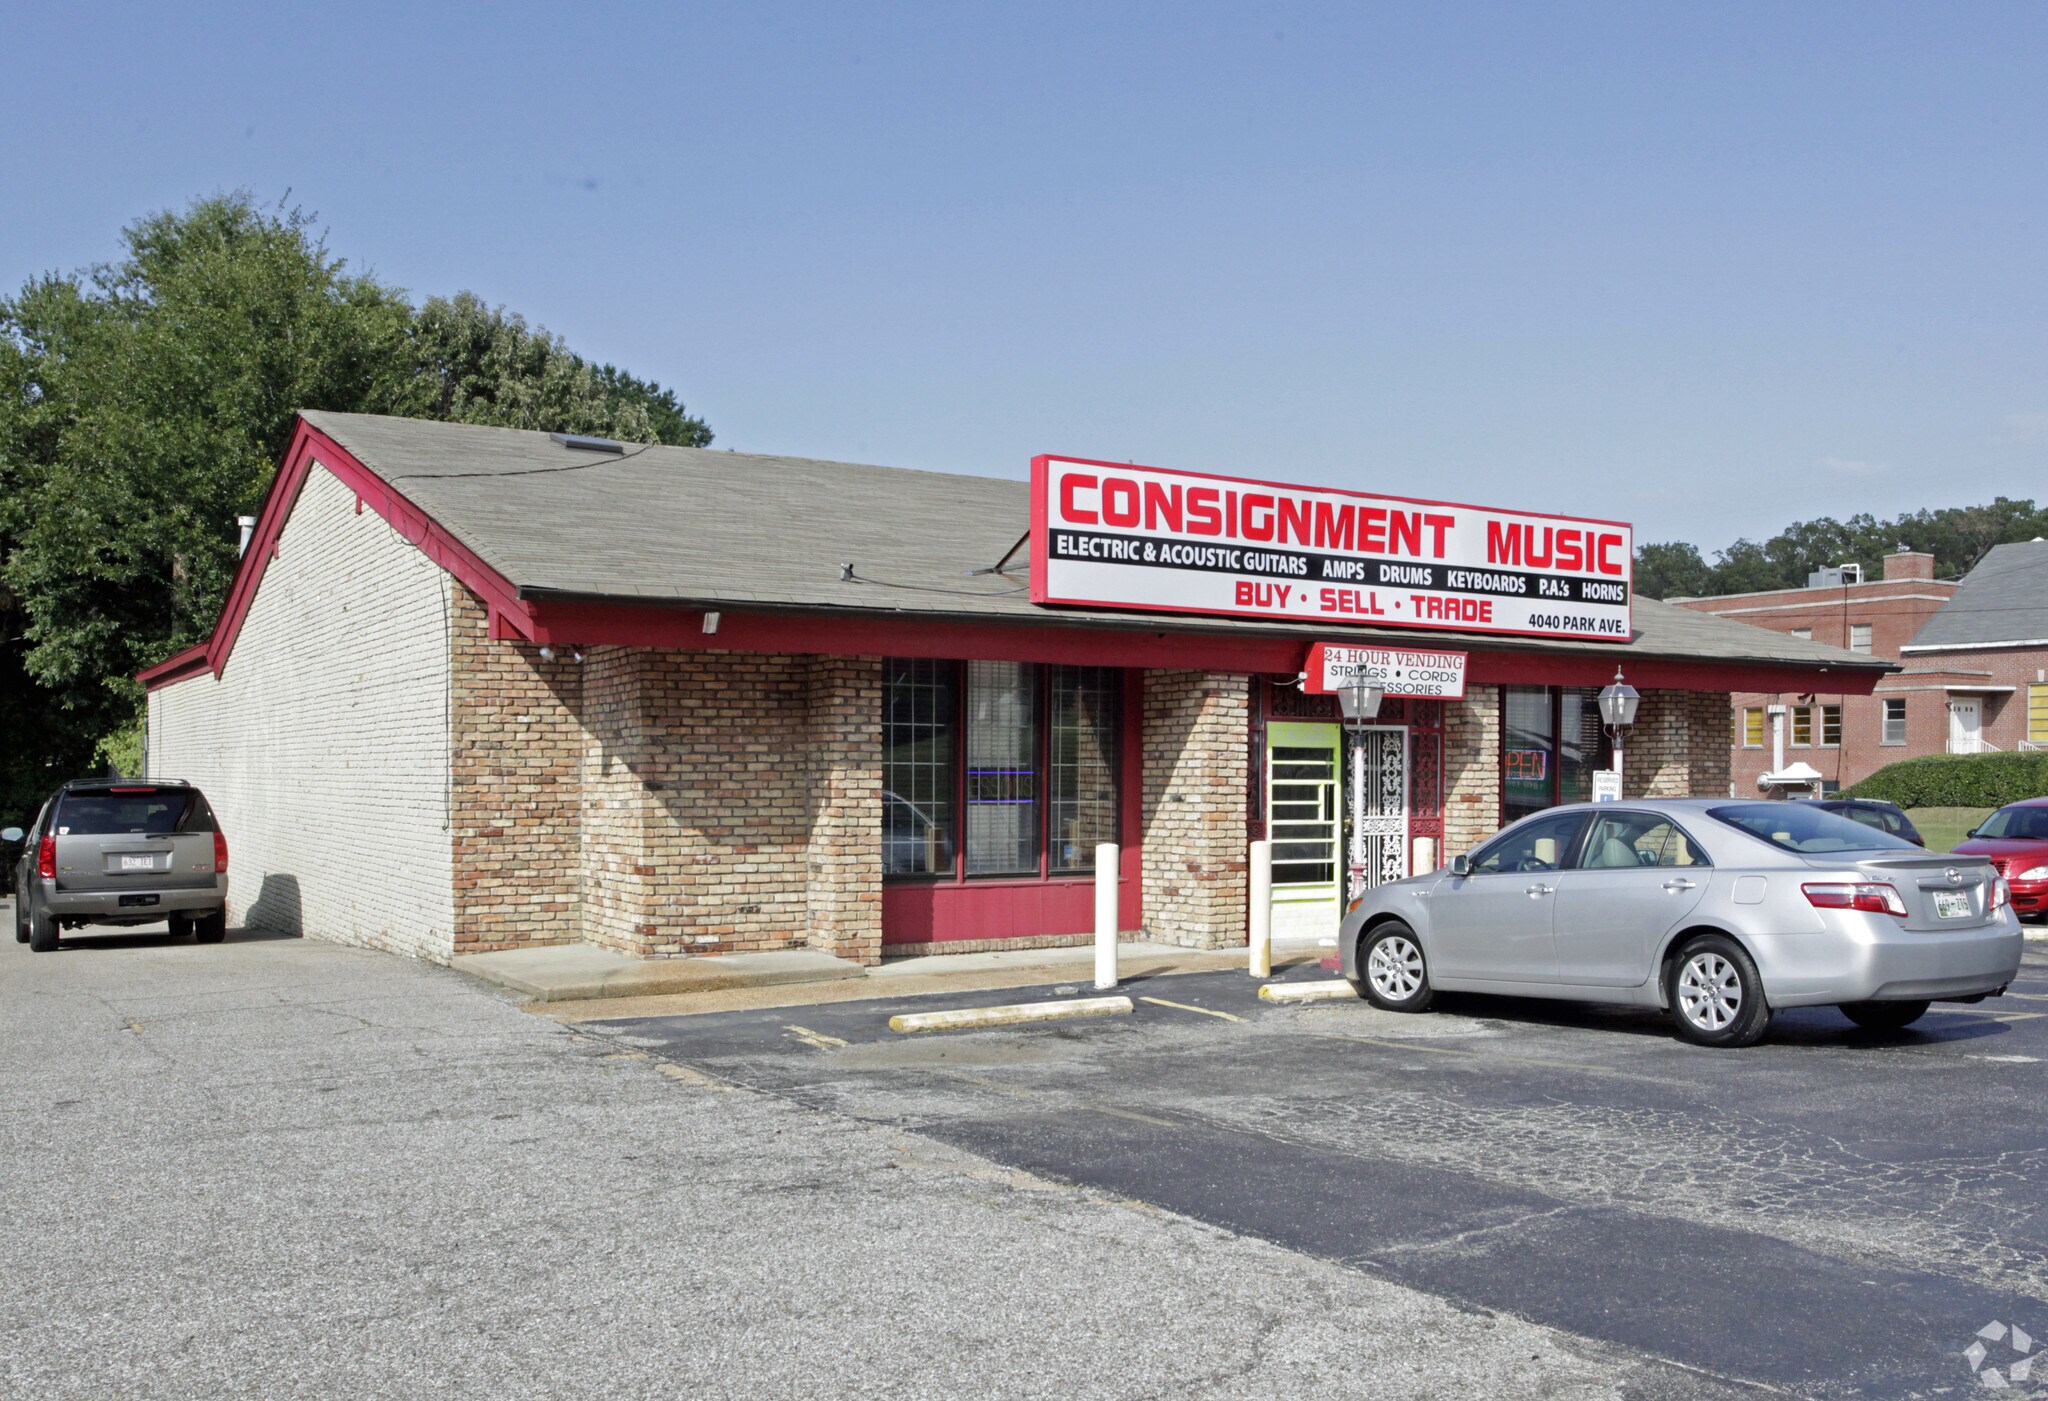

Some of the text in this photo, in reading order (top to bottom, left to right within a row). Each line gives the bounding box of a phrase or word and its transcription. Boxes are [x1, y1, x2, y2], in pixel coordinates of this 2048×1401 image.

[1060, 473, 1623, 576] CONSIGNMENT MUSIC
[1057, 534, 1140, 561] ELECTRIC
[1143, 542, 1156, 563] &
[1160, 543, 1241, 570] ACOUSTIC
[1243, 552, 1308, 575] GUITARS
[1322, 559, 1365, 580] AMPS
[1379, 564, 1432, 586] DRUMS
[1447, 570, 1526, 594] KEYBOARDS
[1582, 582, 1624, 602] HORNS
[1235, 580, 1492, 623] BUY SELL TRADE
[1528, 613, 1626, 634] 4040 PARK AVE.
[1324, 649, 1463, 670] 24 HOUR VENDING
[1408, 669, 1457, 683] CORDS
[1345, 680, 1443, 696] AESSORIES
[1504, 751, 1544, 778] PEN
[970, 776, 1033, 798] ESSONS
